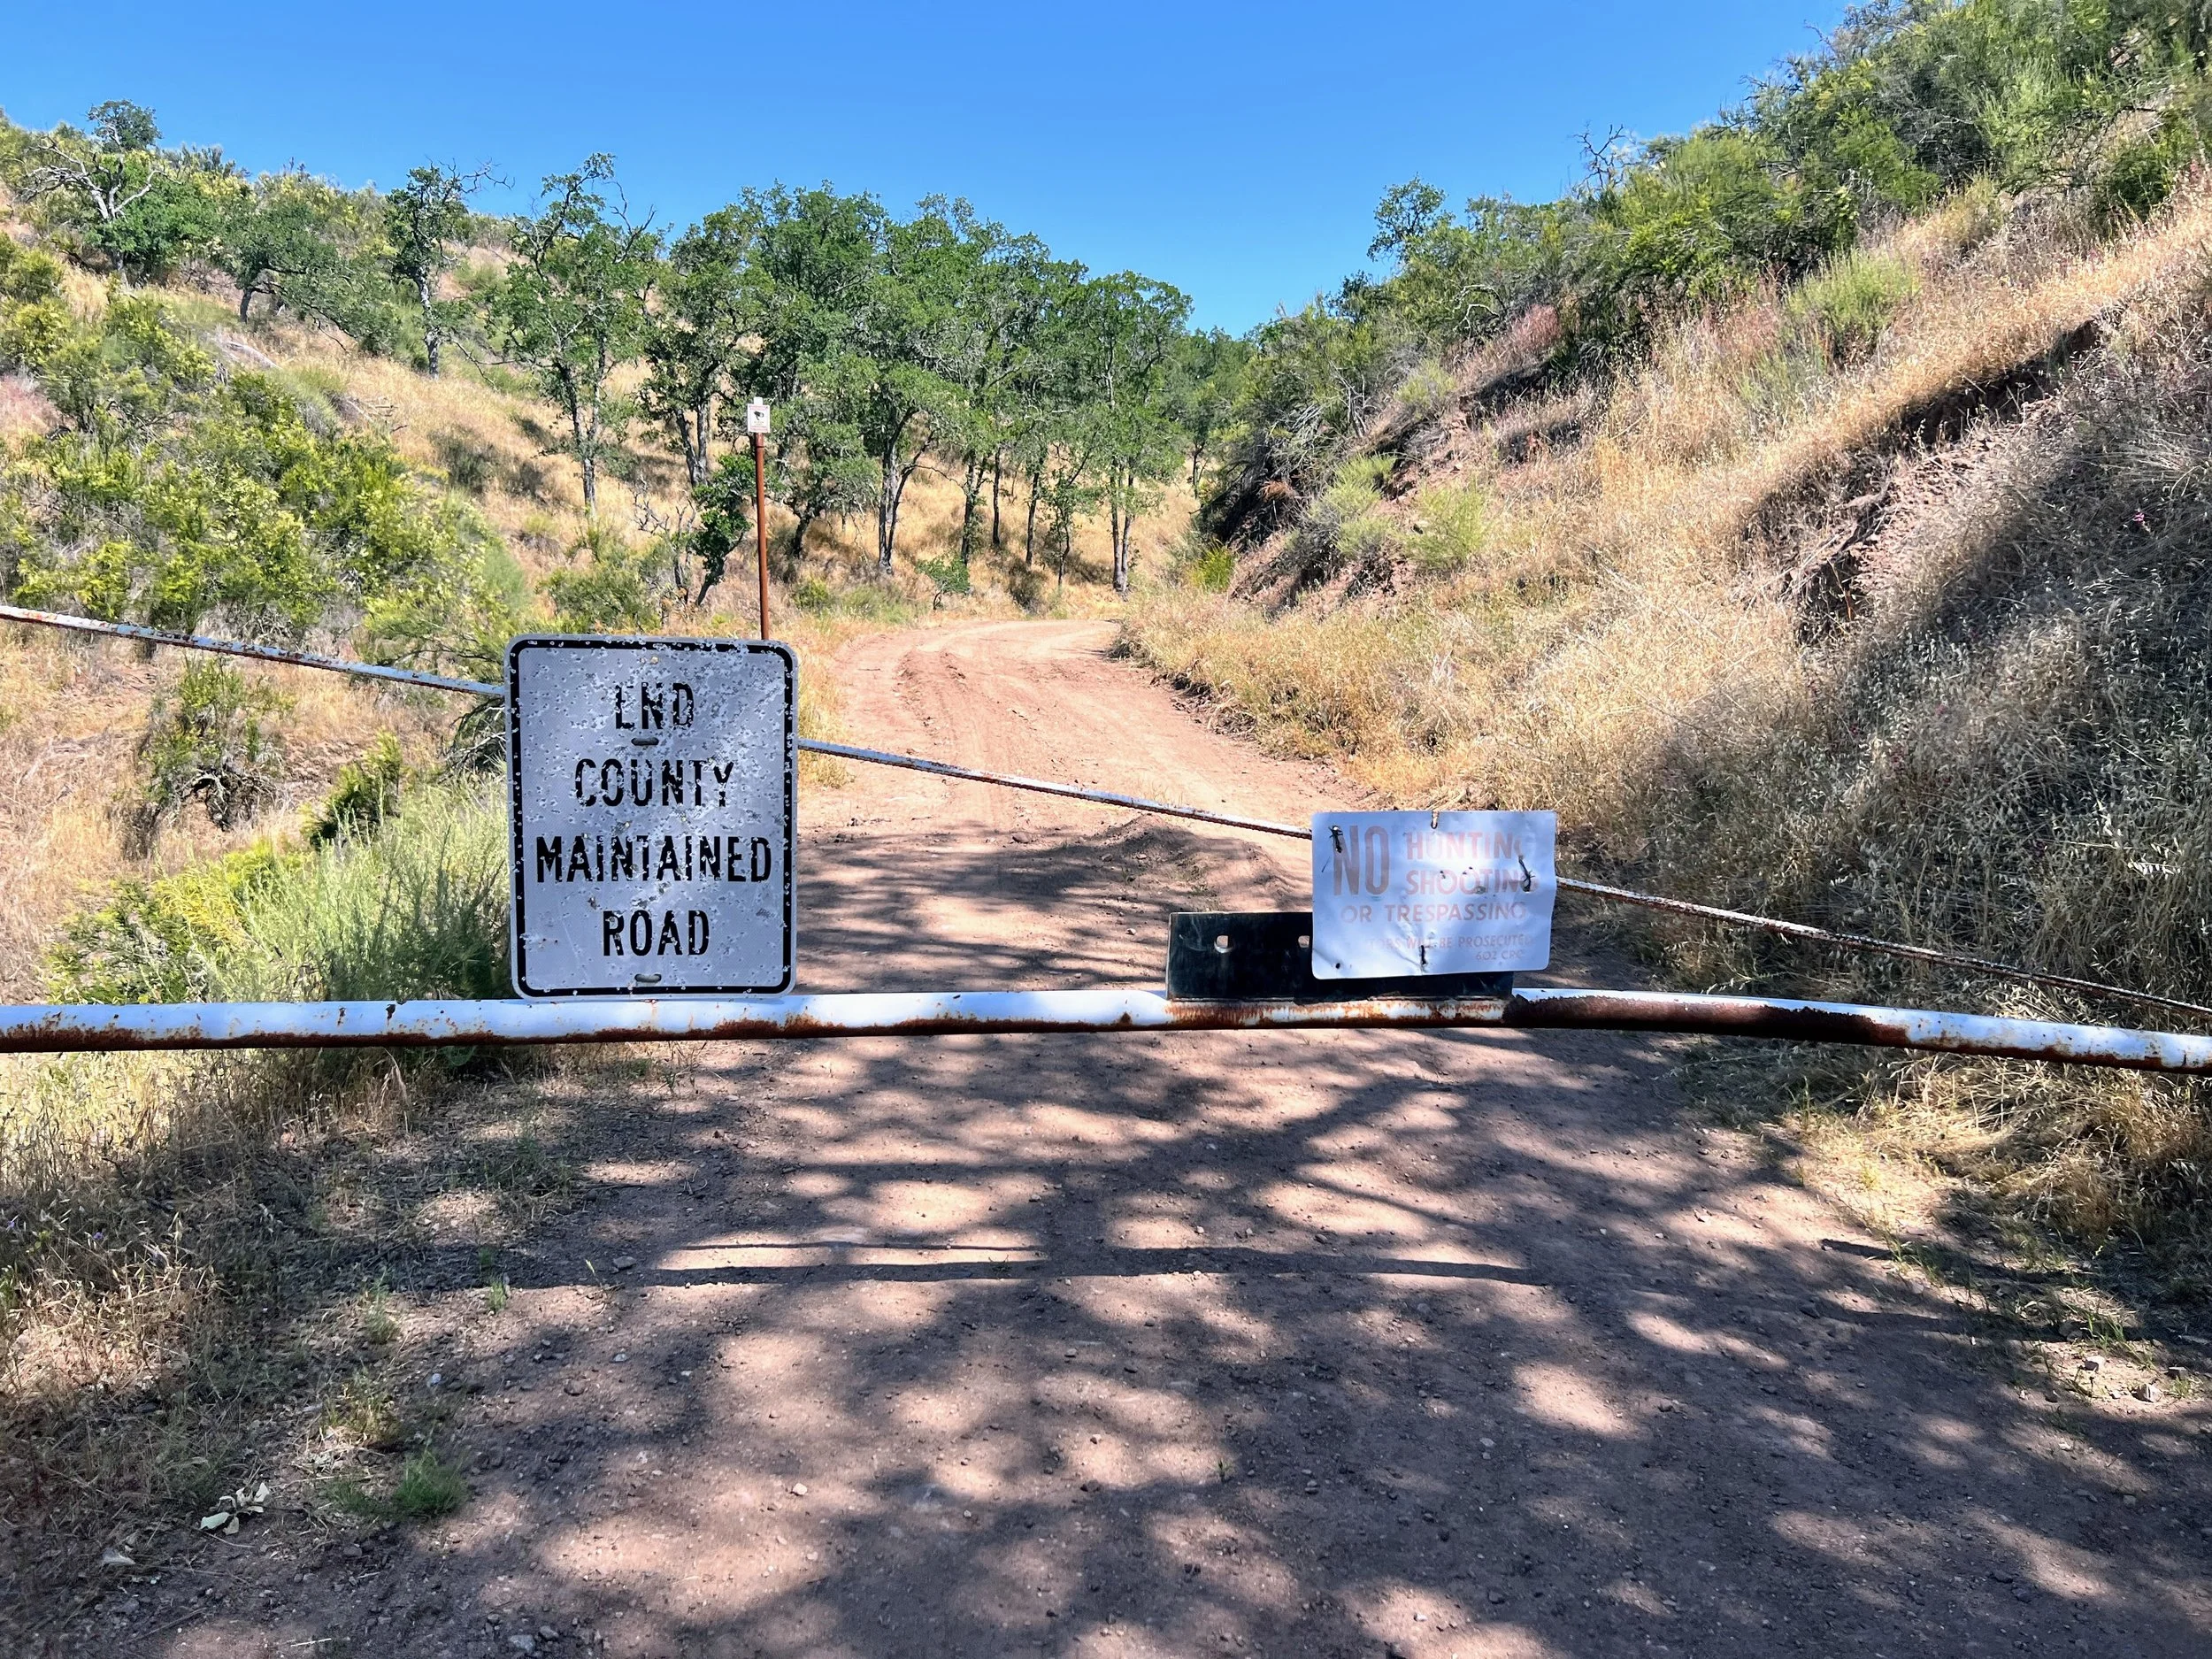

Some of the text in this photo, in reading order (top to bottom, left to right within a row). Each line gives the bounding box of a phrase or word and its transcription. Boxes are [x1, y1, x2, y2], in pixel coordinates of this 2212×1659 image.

[616, 682, 694, 729] END
[575, 758, 733, 807] COUNTY
[536, 835, 772, 883] MAINTAINED
[1333, 825, 1389, 895] NO
[603, 910, 710, 956] ROAD
[1341, 902, 1525, 923] OR TRESPASSING
[1440, 937, 1453, 949] BE
